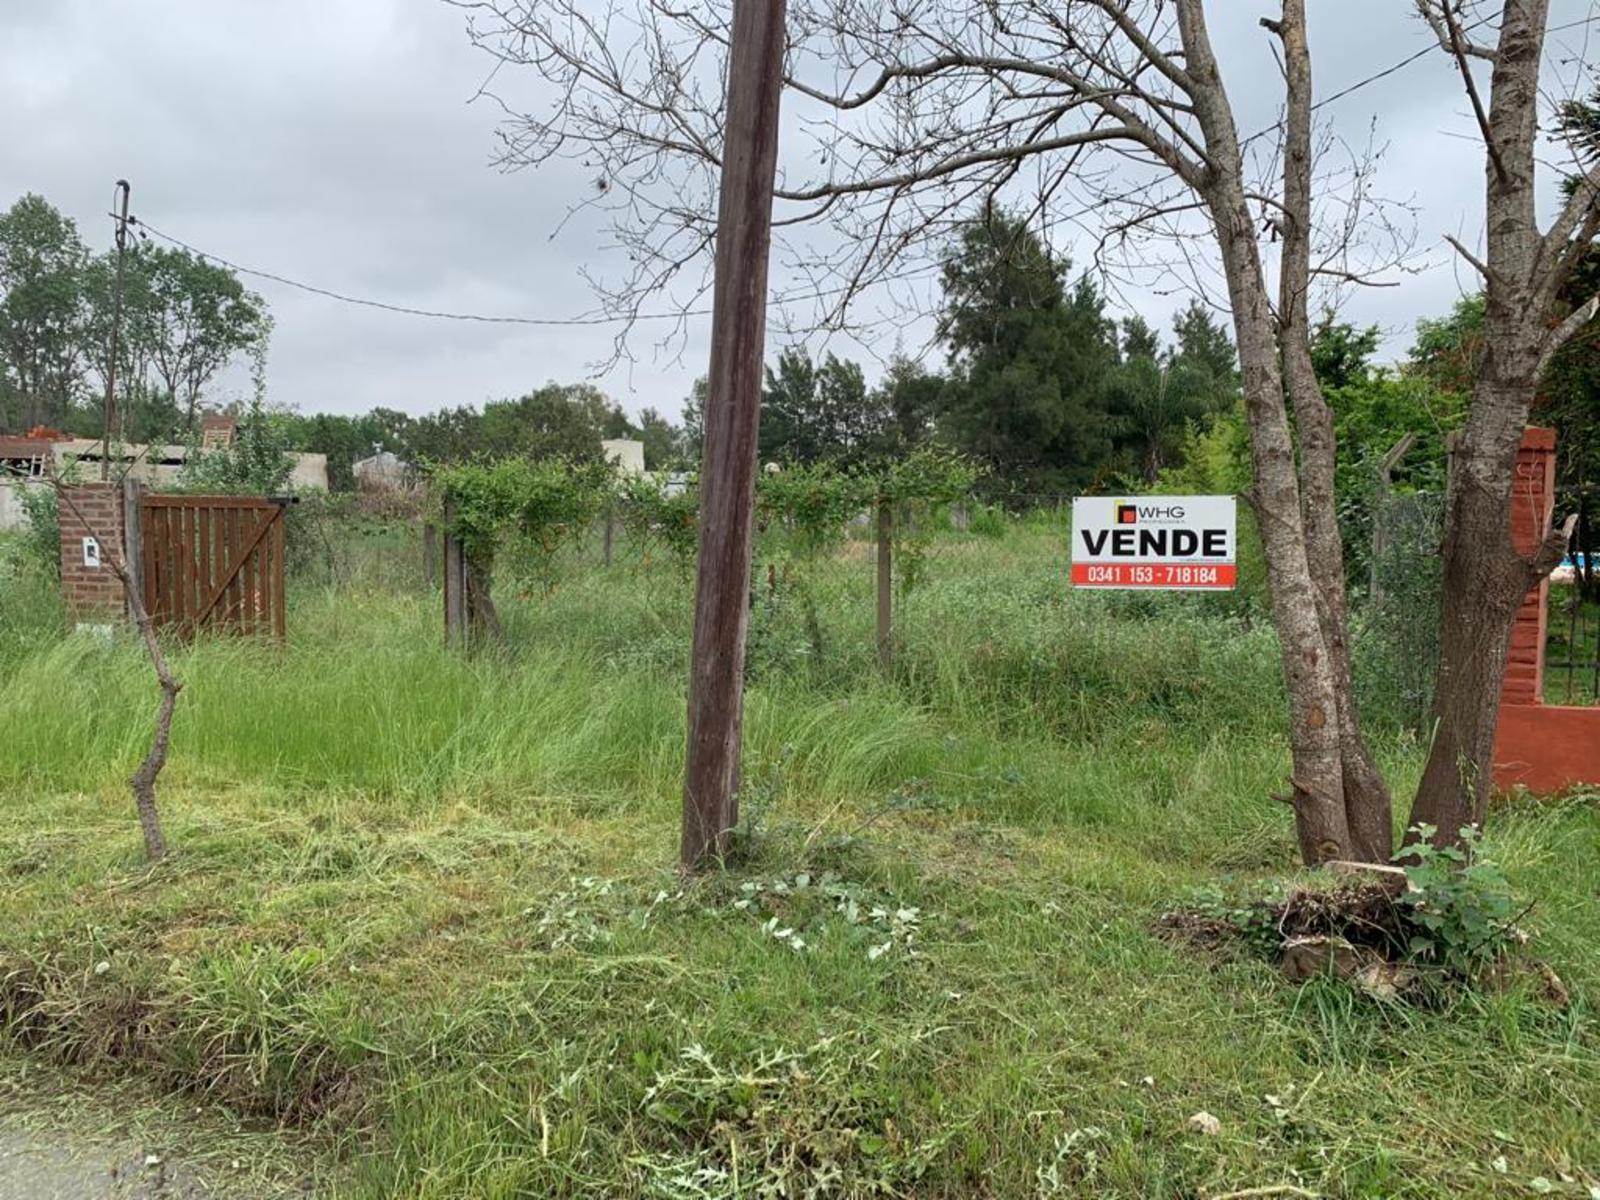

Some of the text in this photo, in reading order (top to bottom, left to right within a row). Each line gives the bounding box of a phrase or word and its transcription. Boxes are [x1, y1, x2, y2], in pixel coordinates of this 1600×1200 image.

[1138, 506, 1185, 518] WHG
[1081, 529, 1227, 556] VENDE
[1088, 566, 1120, 582] 0341
[1129, 566, 1153, 582] 153
[1165, 567, 1217, 583] 718184
